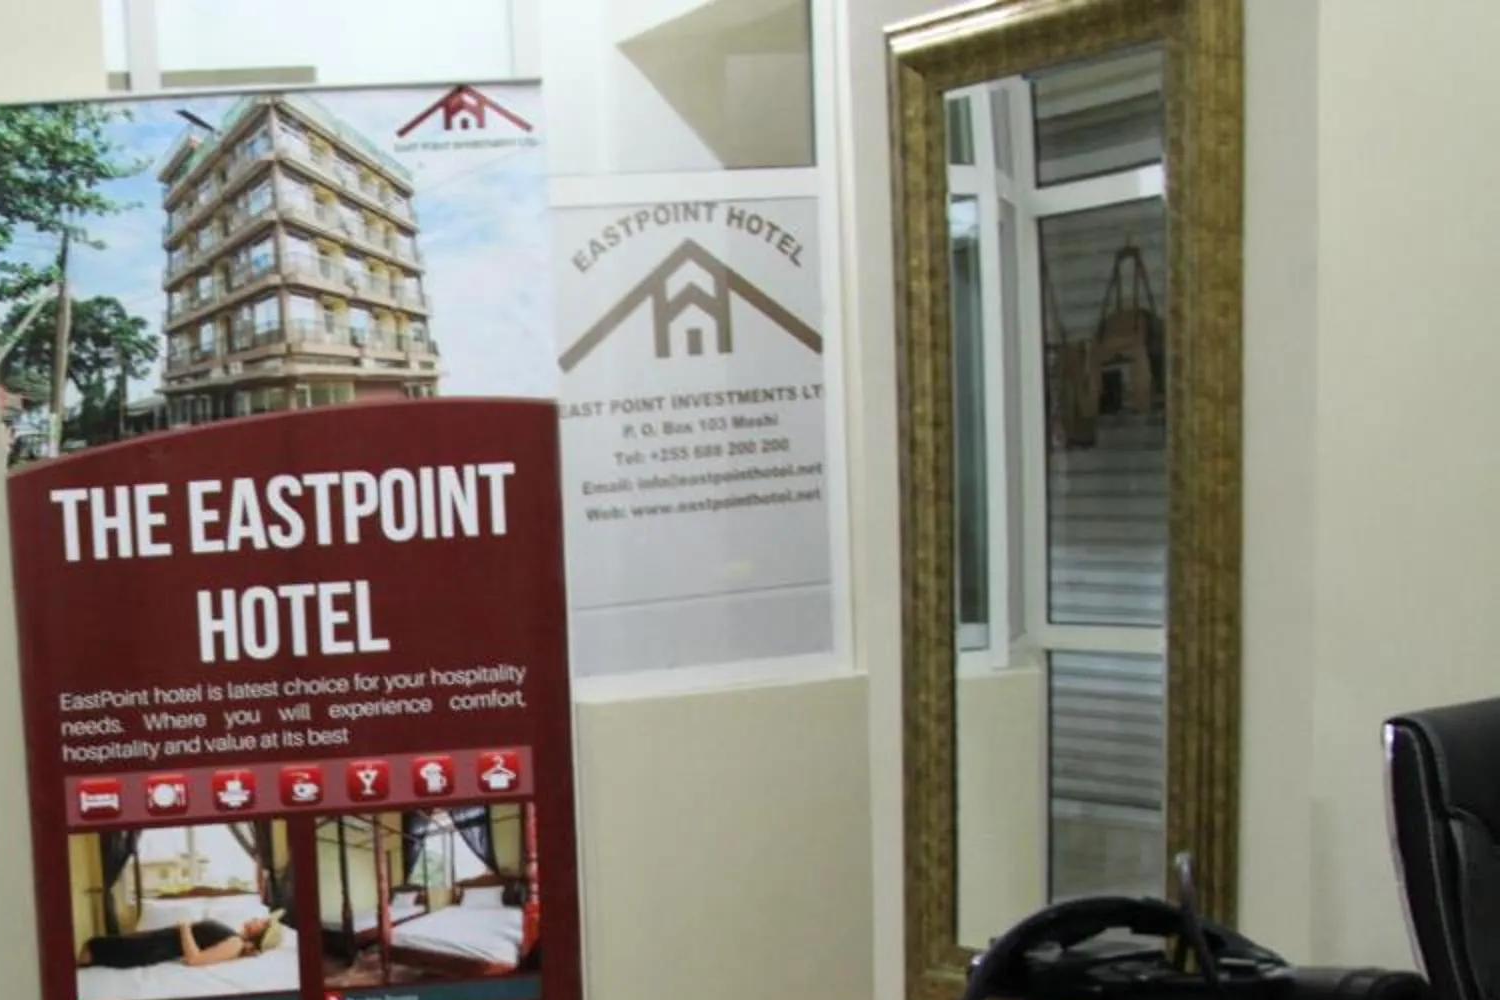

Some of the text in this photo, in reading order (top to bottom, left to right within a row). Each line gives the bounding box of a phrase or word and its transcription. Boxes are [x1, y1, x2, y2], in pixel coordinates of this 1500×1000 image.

[571, 201, 805, 273] EASTPOINT HOTEL
[610, 396, 666, 415] POINT
[672, 386, 797, 411] INVESTMENTS
[662, 420, 693, 435] Box
[732, 414, 779, 431] Moshi
[650, 446, 690, 462] +255
[582, 480, 633, 496] Email:
[50, 462, 515, 563] THE EASTPOINT
[197, 580, 390, 663] HOTEL
[60, 664, 527, 711] EastPoint hotel is latest choice for your hospitality
[61, 716, 124, 737] needs.
[142, 711, 207, 731] Where
[224, 709, 260, 730] you
[278, 702, 311, 721] will
[328, 697, 432, 721] experience
[62, 727, 350, 763] hospitality and value at its best
